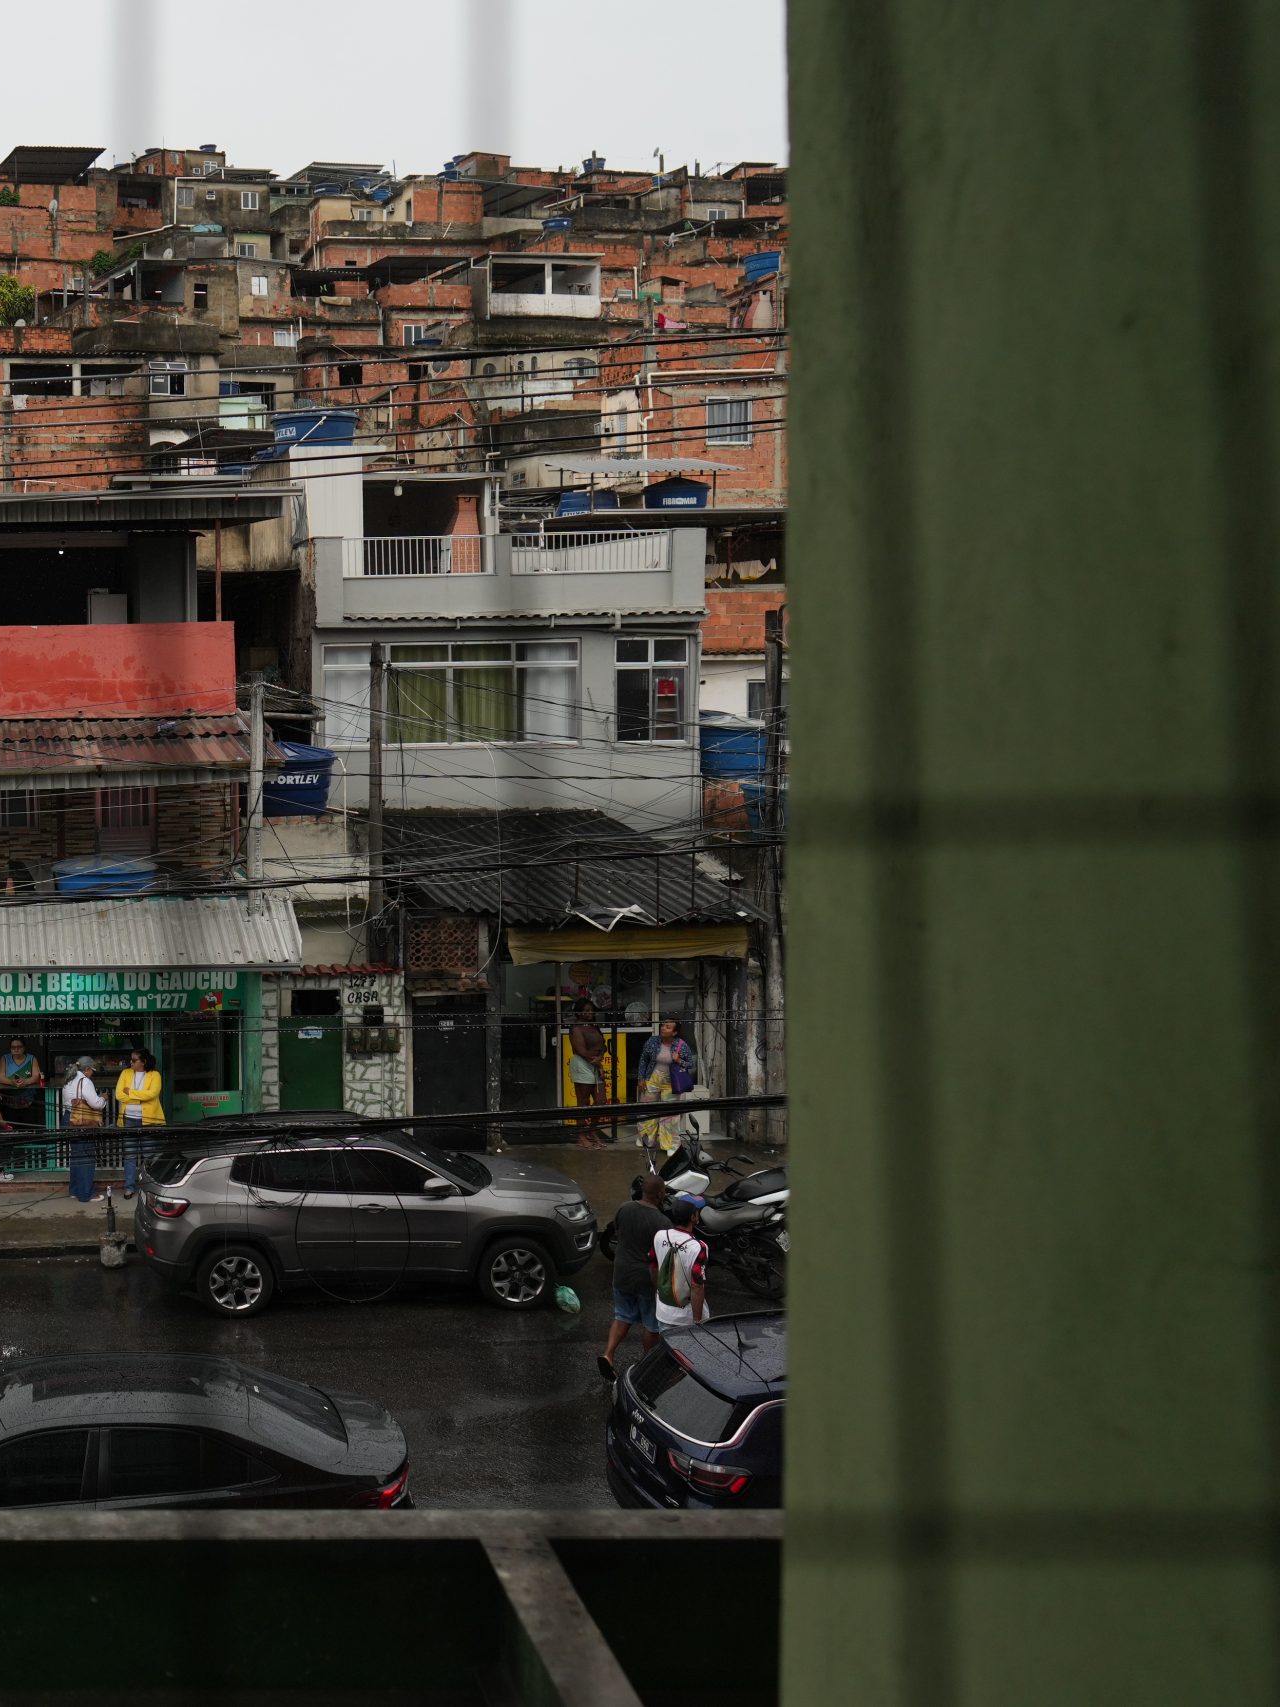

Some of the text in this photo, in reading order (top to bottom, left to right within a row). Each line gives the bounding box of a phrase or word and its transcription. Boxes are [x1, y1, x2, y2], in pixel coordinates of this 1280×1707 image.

[17, 973, 43, 993] DE
[46, 972, 120, 993] BEBIDA
[123, 972, 151, 992] DO
[155, 972, 238, 991] GAUCHO
[349, 974, 377, 989] 1277
[39, 992, 77, 1011] JOSÉ
[78, 993, 134, 1011] RUCAS,
[347, 990, 379, 1004] CASA
[661, 1240, 689, 1253] pibet
